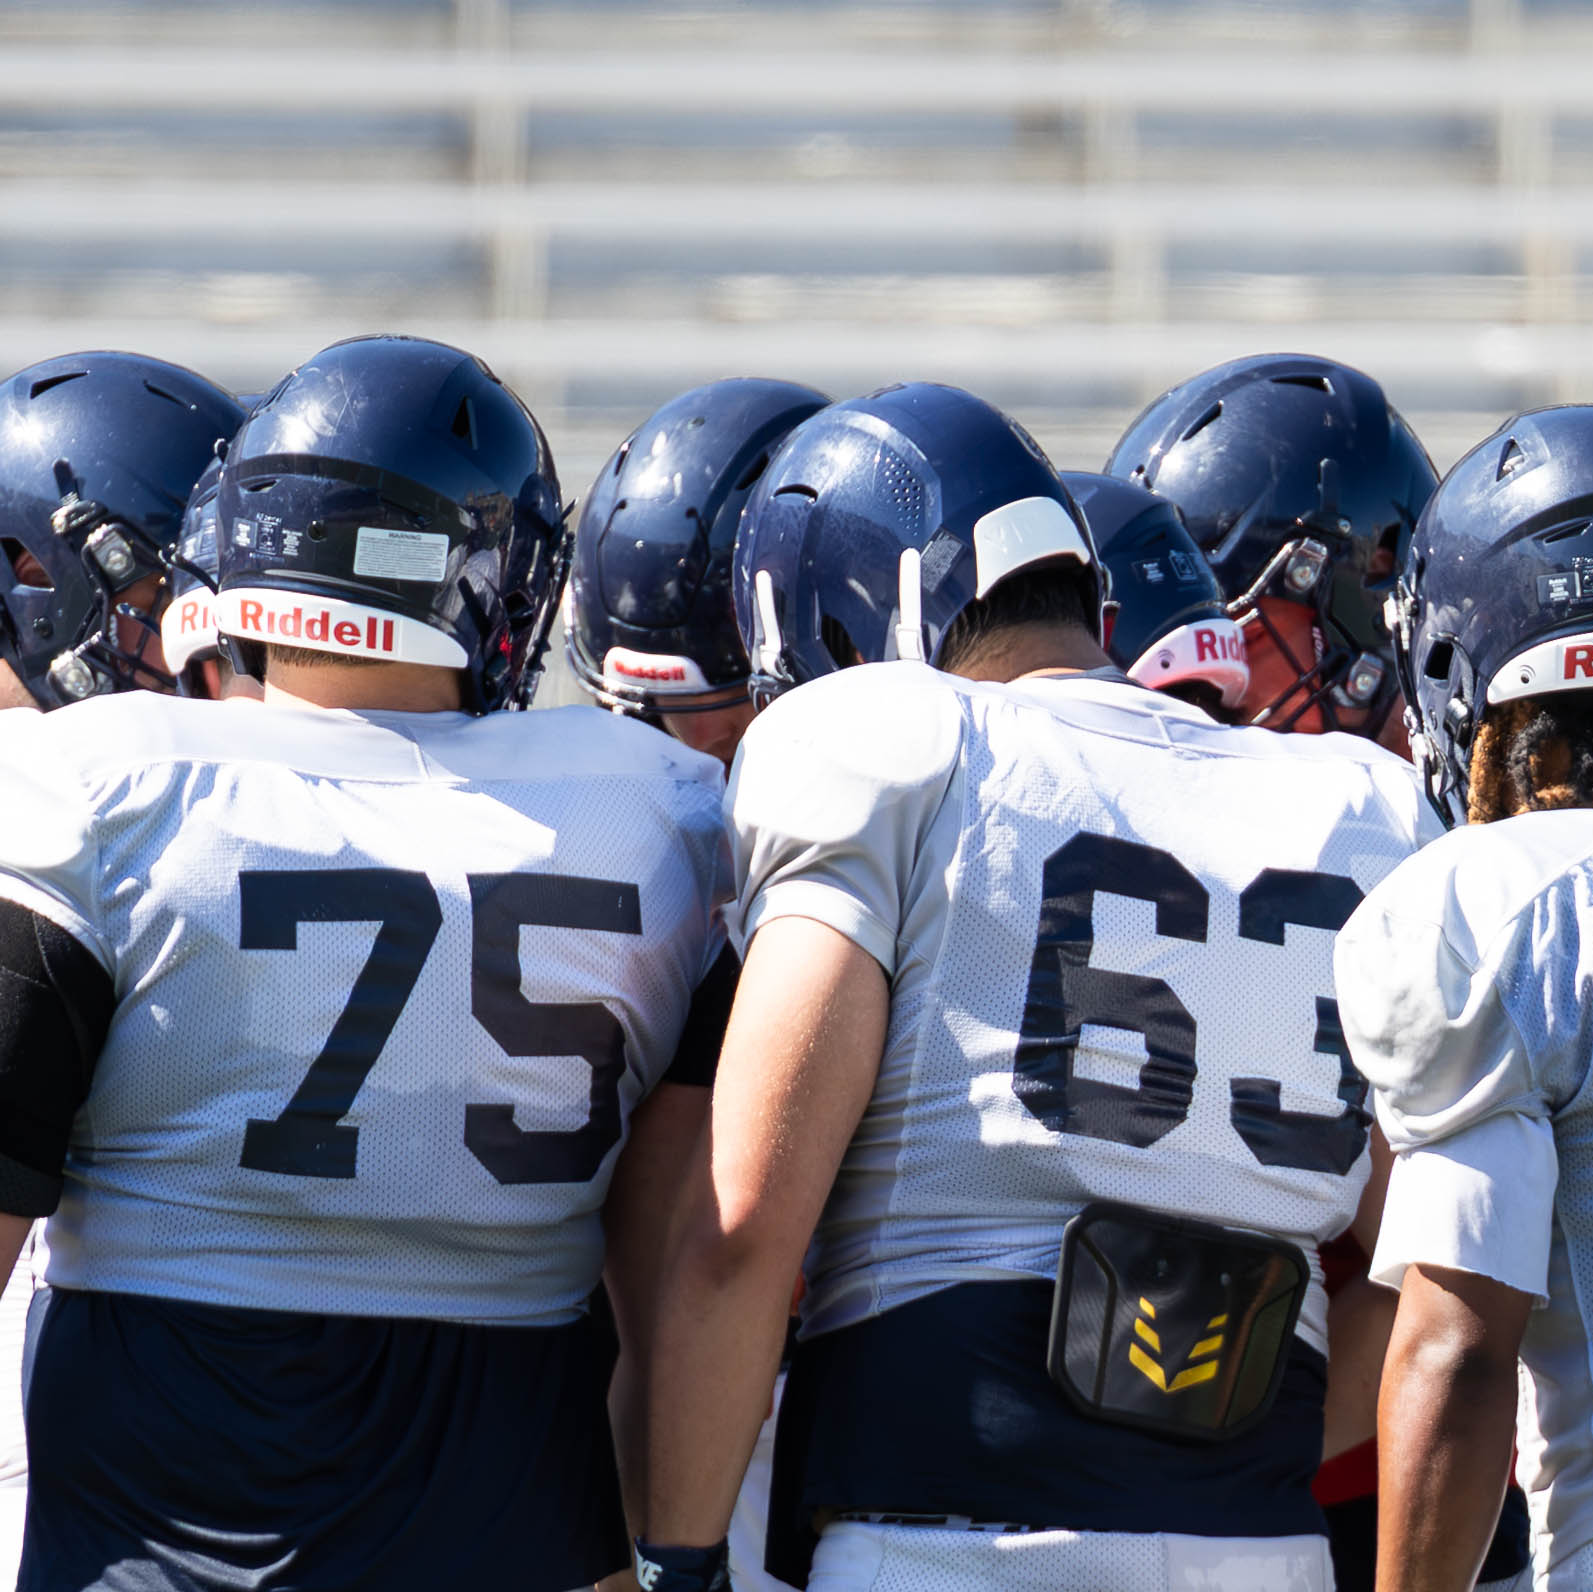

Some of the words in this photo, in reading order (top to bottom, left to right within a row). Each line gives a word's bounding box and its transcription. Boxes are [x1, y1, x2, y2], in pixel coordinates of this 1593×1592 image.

[240, 599, 394, 652] Riddell
[237, 867, 643, 1185] 75
[1011, 831, 1374, 1176] 63
